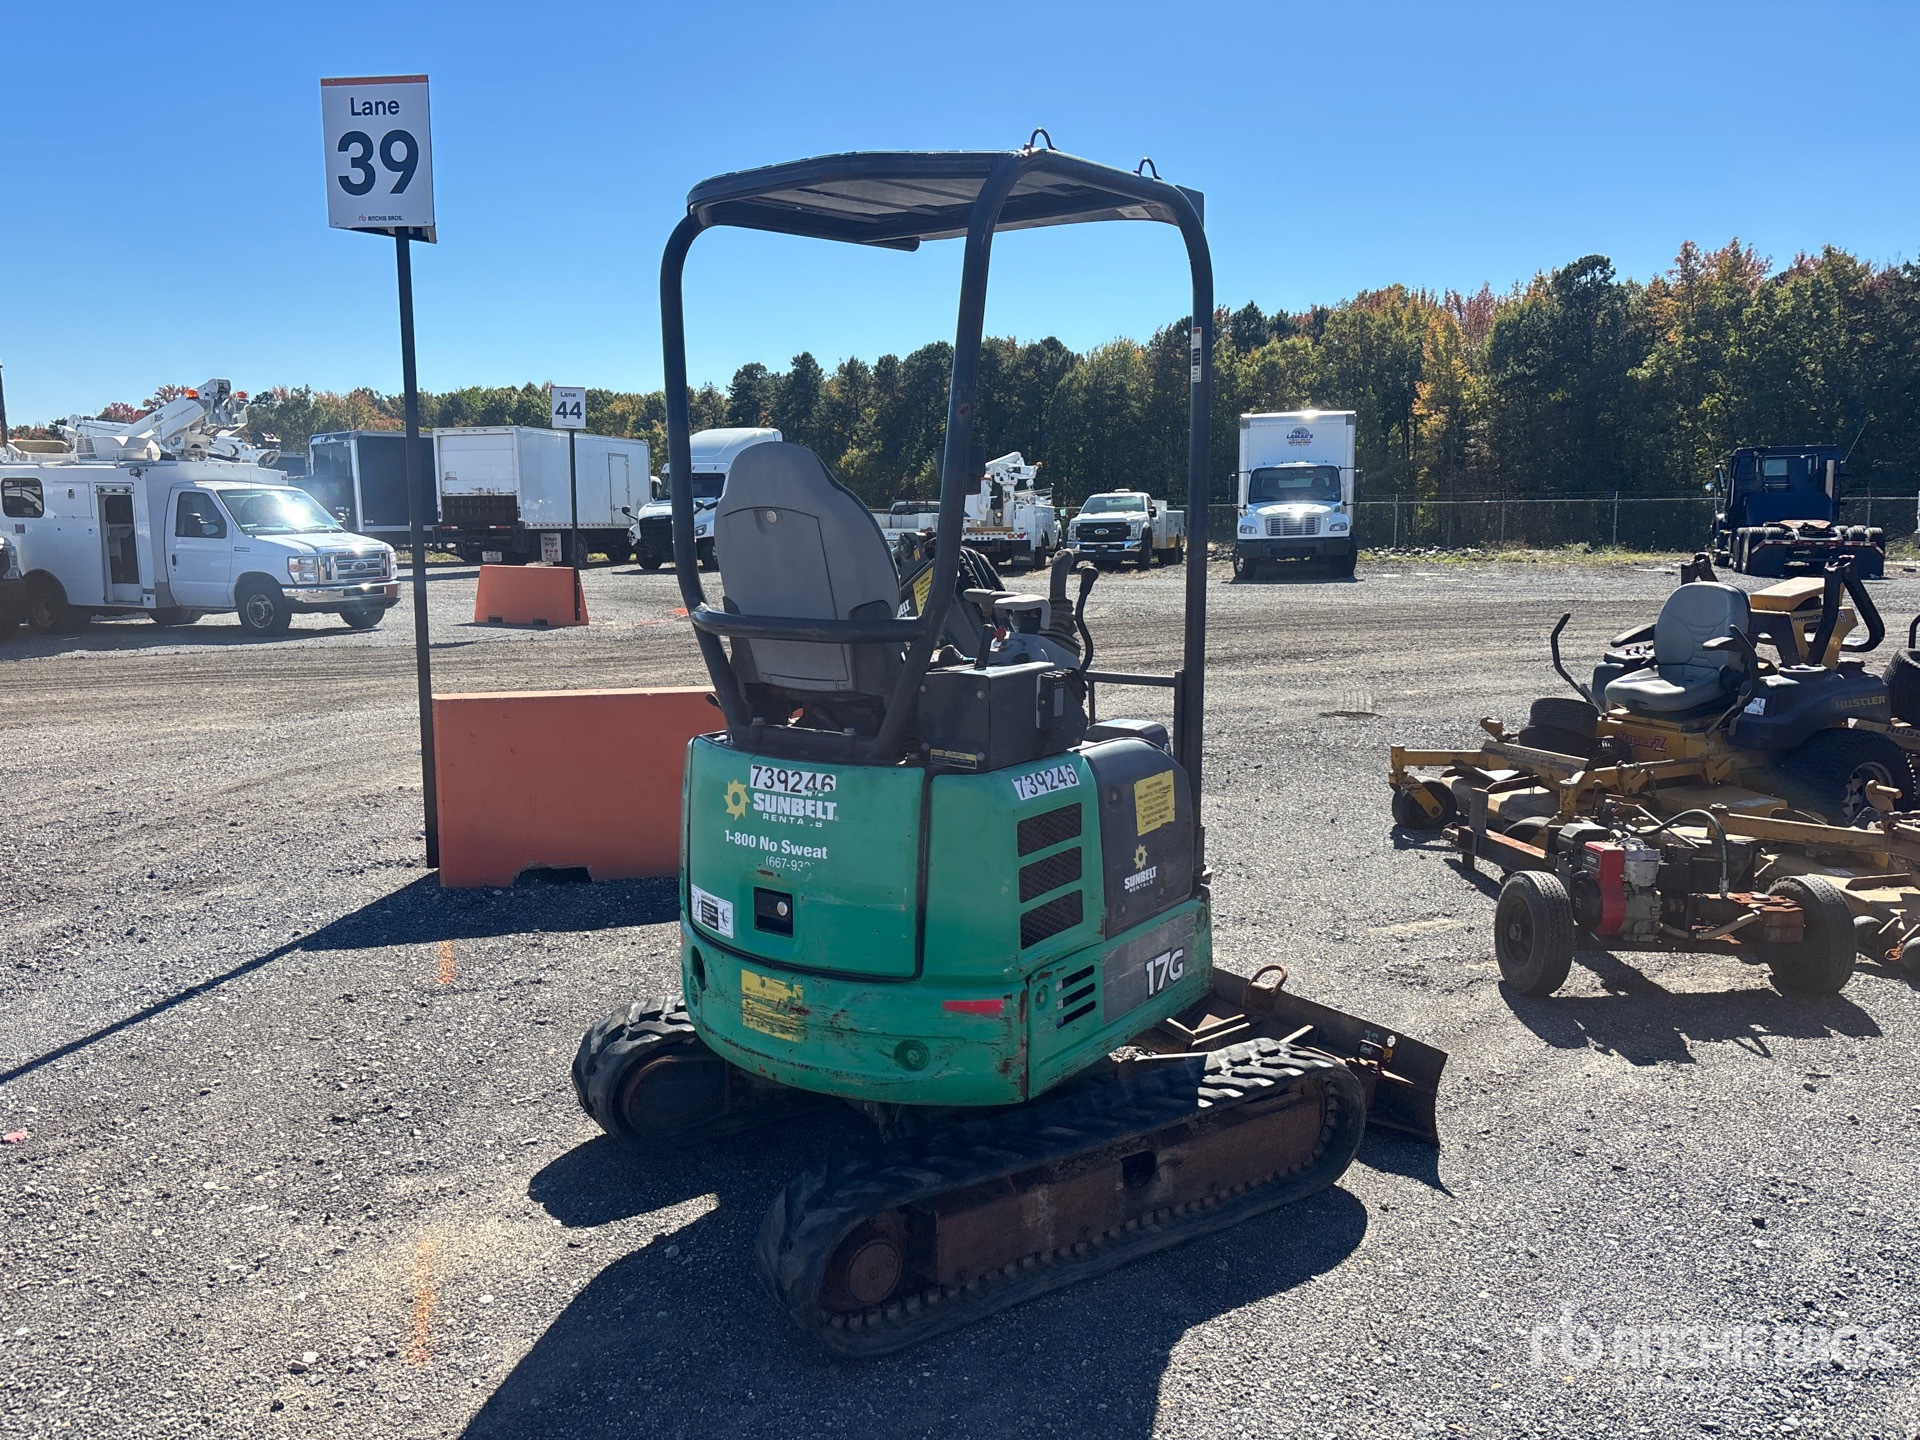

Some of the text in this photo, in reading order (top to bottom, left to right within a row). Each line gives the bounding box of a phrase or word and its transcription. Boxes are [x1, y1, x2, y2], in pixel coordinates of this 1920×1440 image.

[350, 97, 400, 116] Lane
[337, 129, 419, 196] 39
[555, 401, 582, 419] 44
[1834, 695, 1886, 710] HUSTLER
[752, 765, 834, 794] 739246
[1013, 764, 1077, 799] 739246
[753, 792, 837, 821] SUNBELT
[762, 813, 823, 828] RENTAS
[725, 829, 828, 860] 1-800 No Sweat
[1124, 865, 1157, 890] SUNBELT
[1145, 948, 1184, 997] 17G
